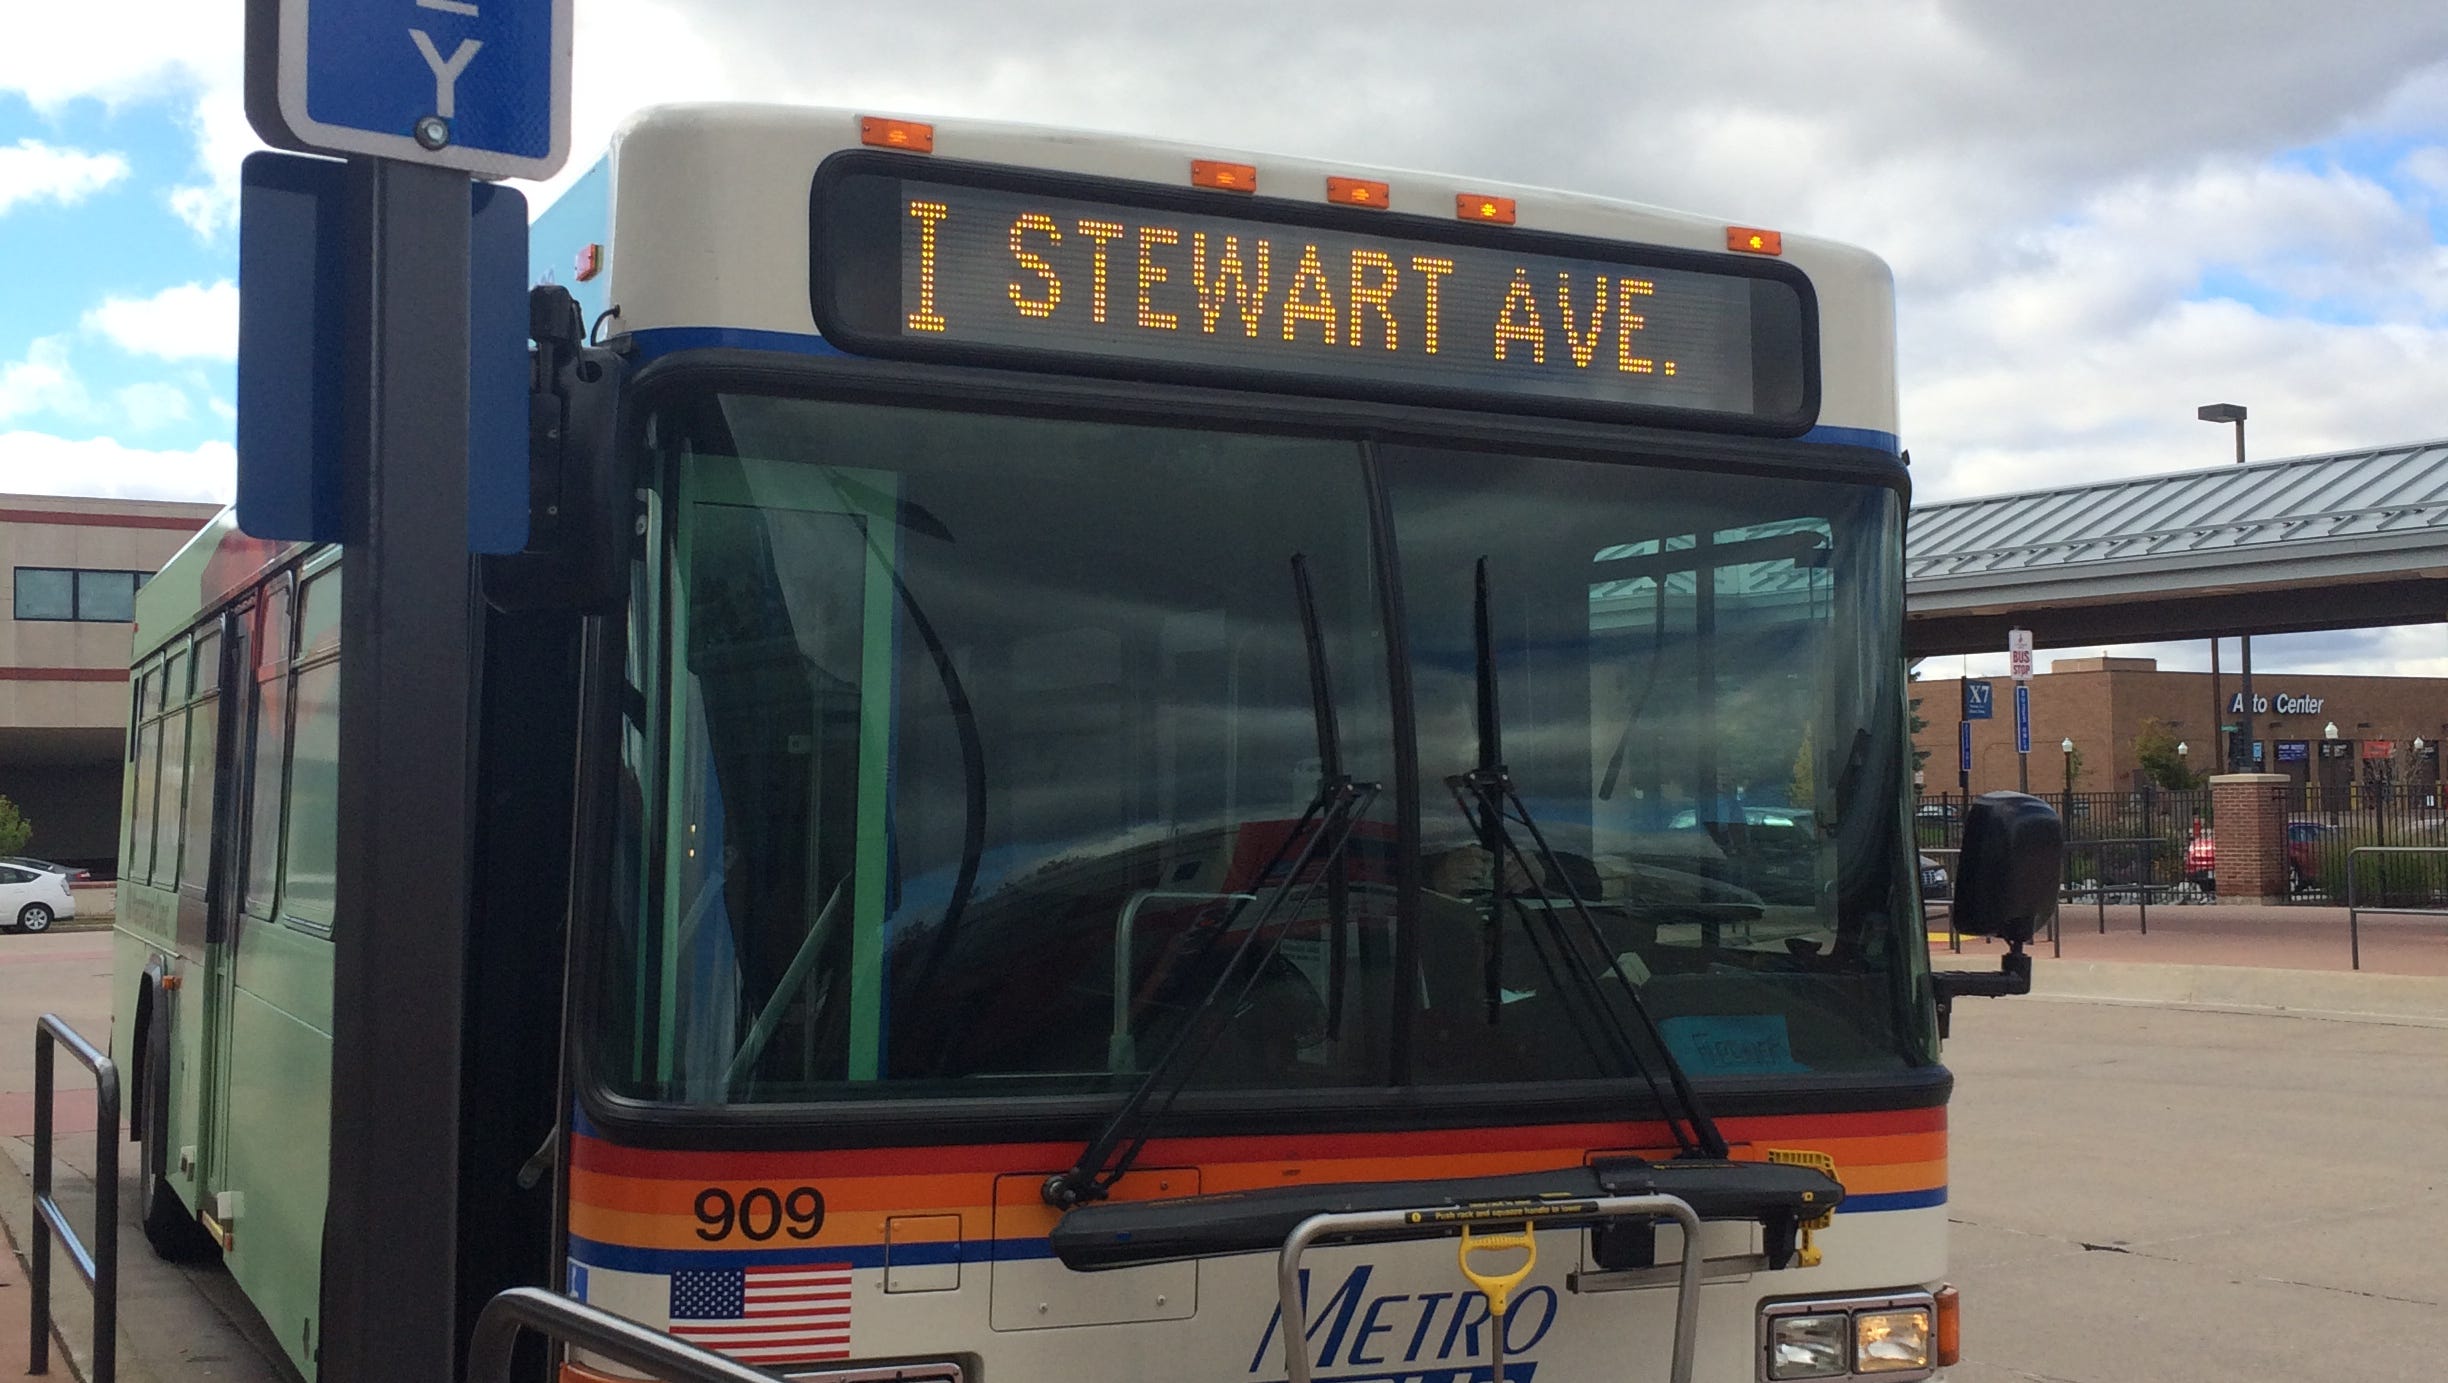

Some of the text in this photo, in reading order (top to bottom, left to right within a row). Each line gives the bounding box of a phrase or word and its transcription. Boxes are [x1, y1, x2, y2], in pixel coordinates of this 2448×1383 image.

[1009, 212, 1454, 355] STEWART
[1494, 267, 1677, 377] AVE.
[2013, 650, 2030, 663] BUS
[2013, 664, 2031, 675] STOP
[1969, 685, 1990, 704] X7
[2231, 693, 2324, 714] Ato Center
[694, 1186, 826, 1242] 909
[1435, 1211, 1456, 1220] Push
[1249, 1264, 1558, 1373] METRO
